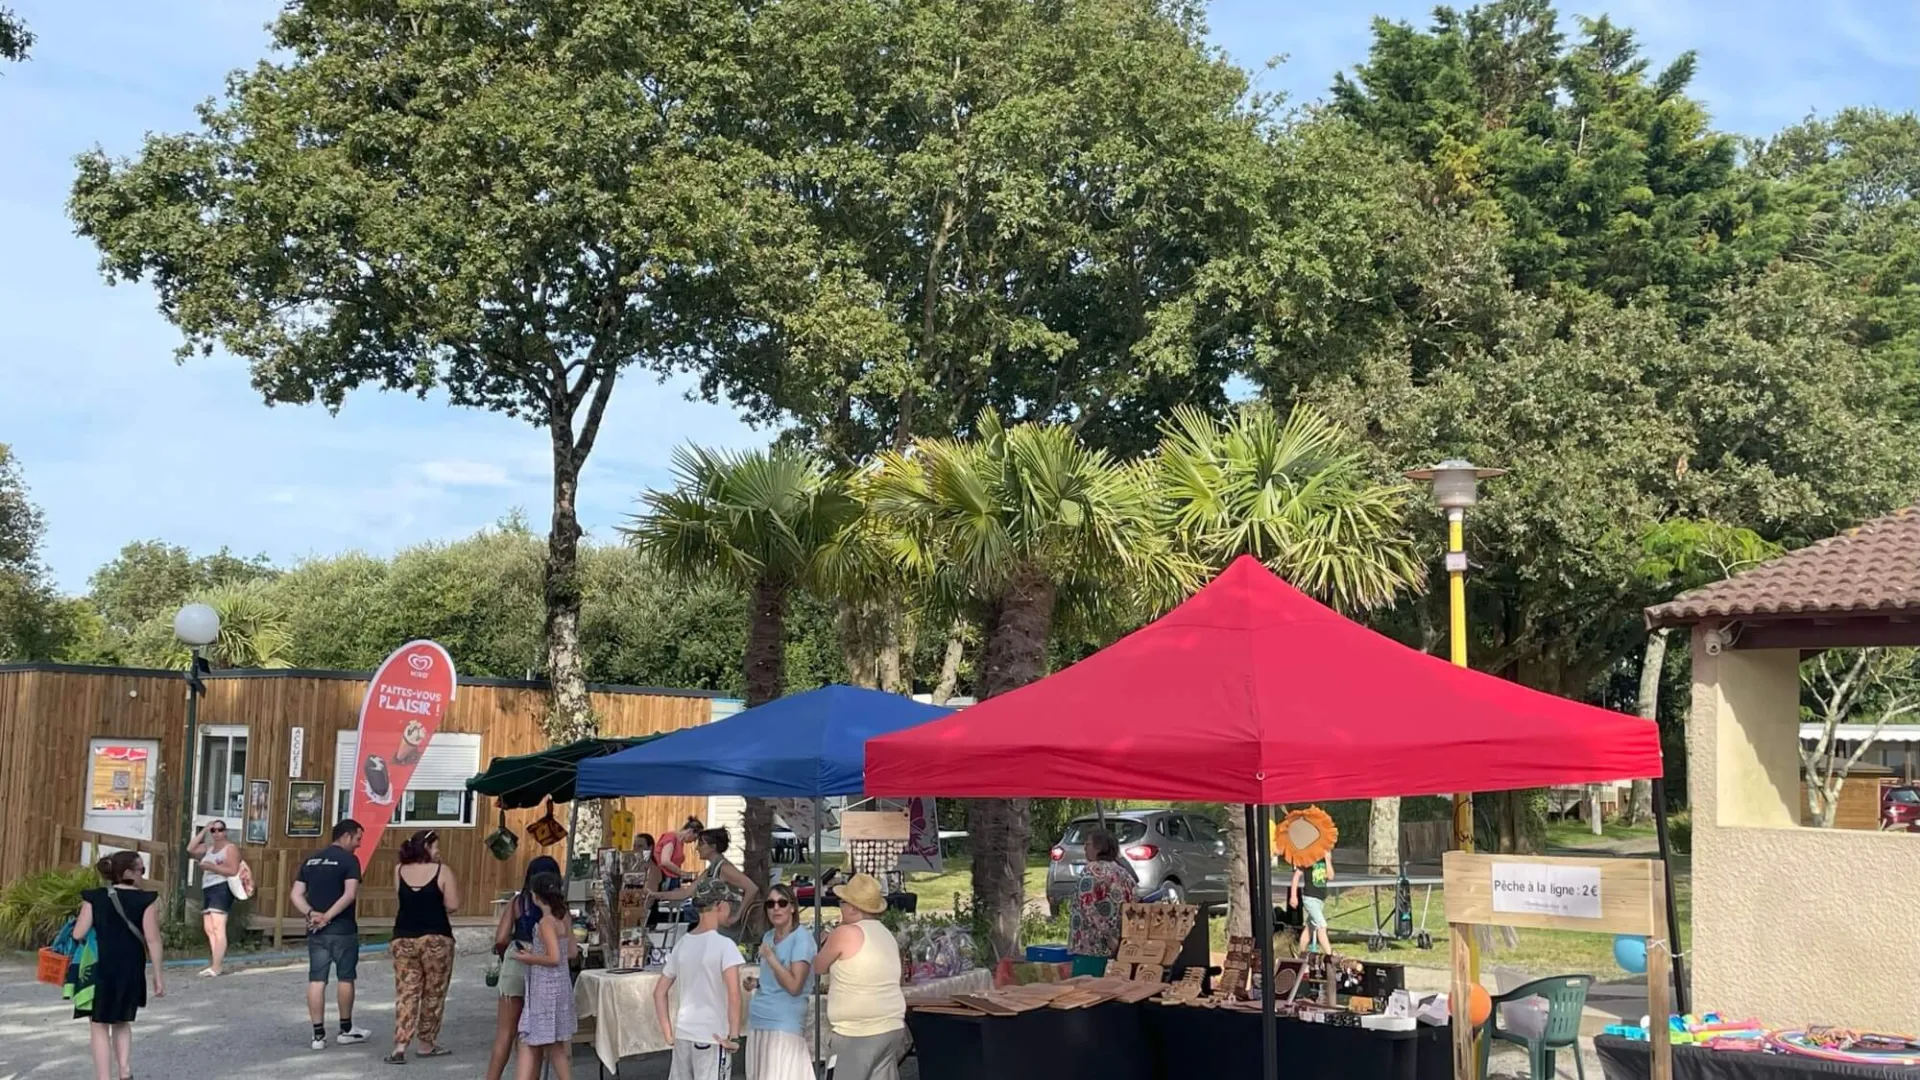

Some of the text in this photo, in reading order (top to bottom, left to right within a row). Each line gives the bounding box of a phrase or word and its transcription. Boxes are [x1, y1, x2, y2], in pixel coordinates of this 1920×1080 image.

[380, 684, 442, 702] FAITES-VOUS
[379, 694, 431, 716] PLAISIR
[1537, 882, 1546, 893] la
[1550, 884, 1575, 897] ligne
